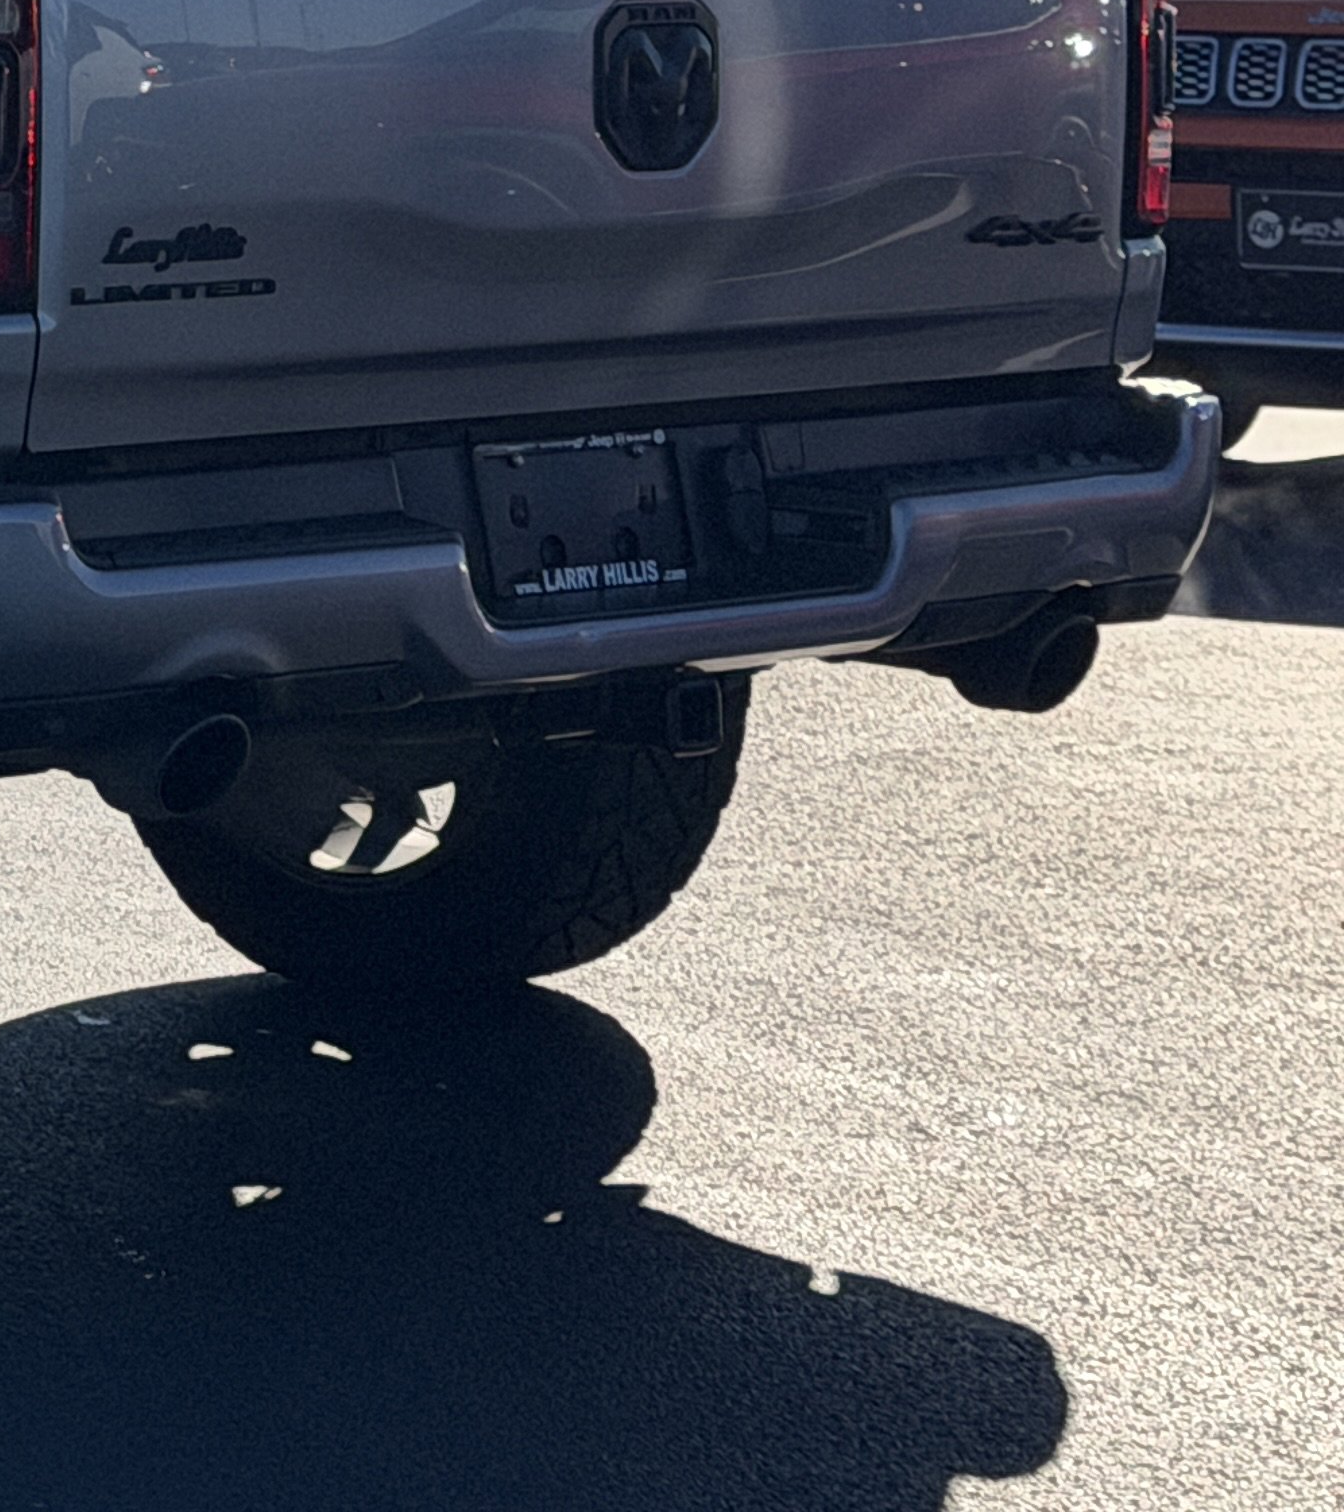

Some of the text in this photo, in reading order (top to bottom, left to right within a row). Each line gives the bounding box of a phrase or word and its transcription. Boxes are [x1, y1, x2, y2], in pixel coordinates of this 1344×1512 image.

[70, 278, 276, 305] LIMITED
[542, 565, 598, 592] LARRY
[602, 560, 659, 586] HILLIS
